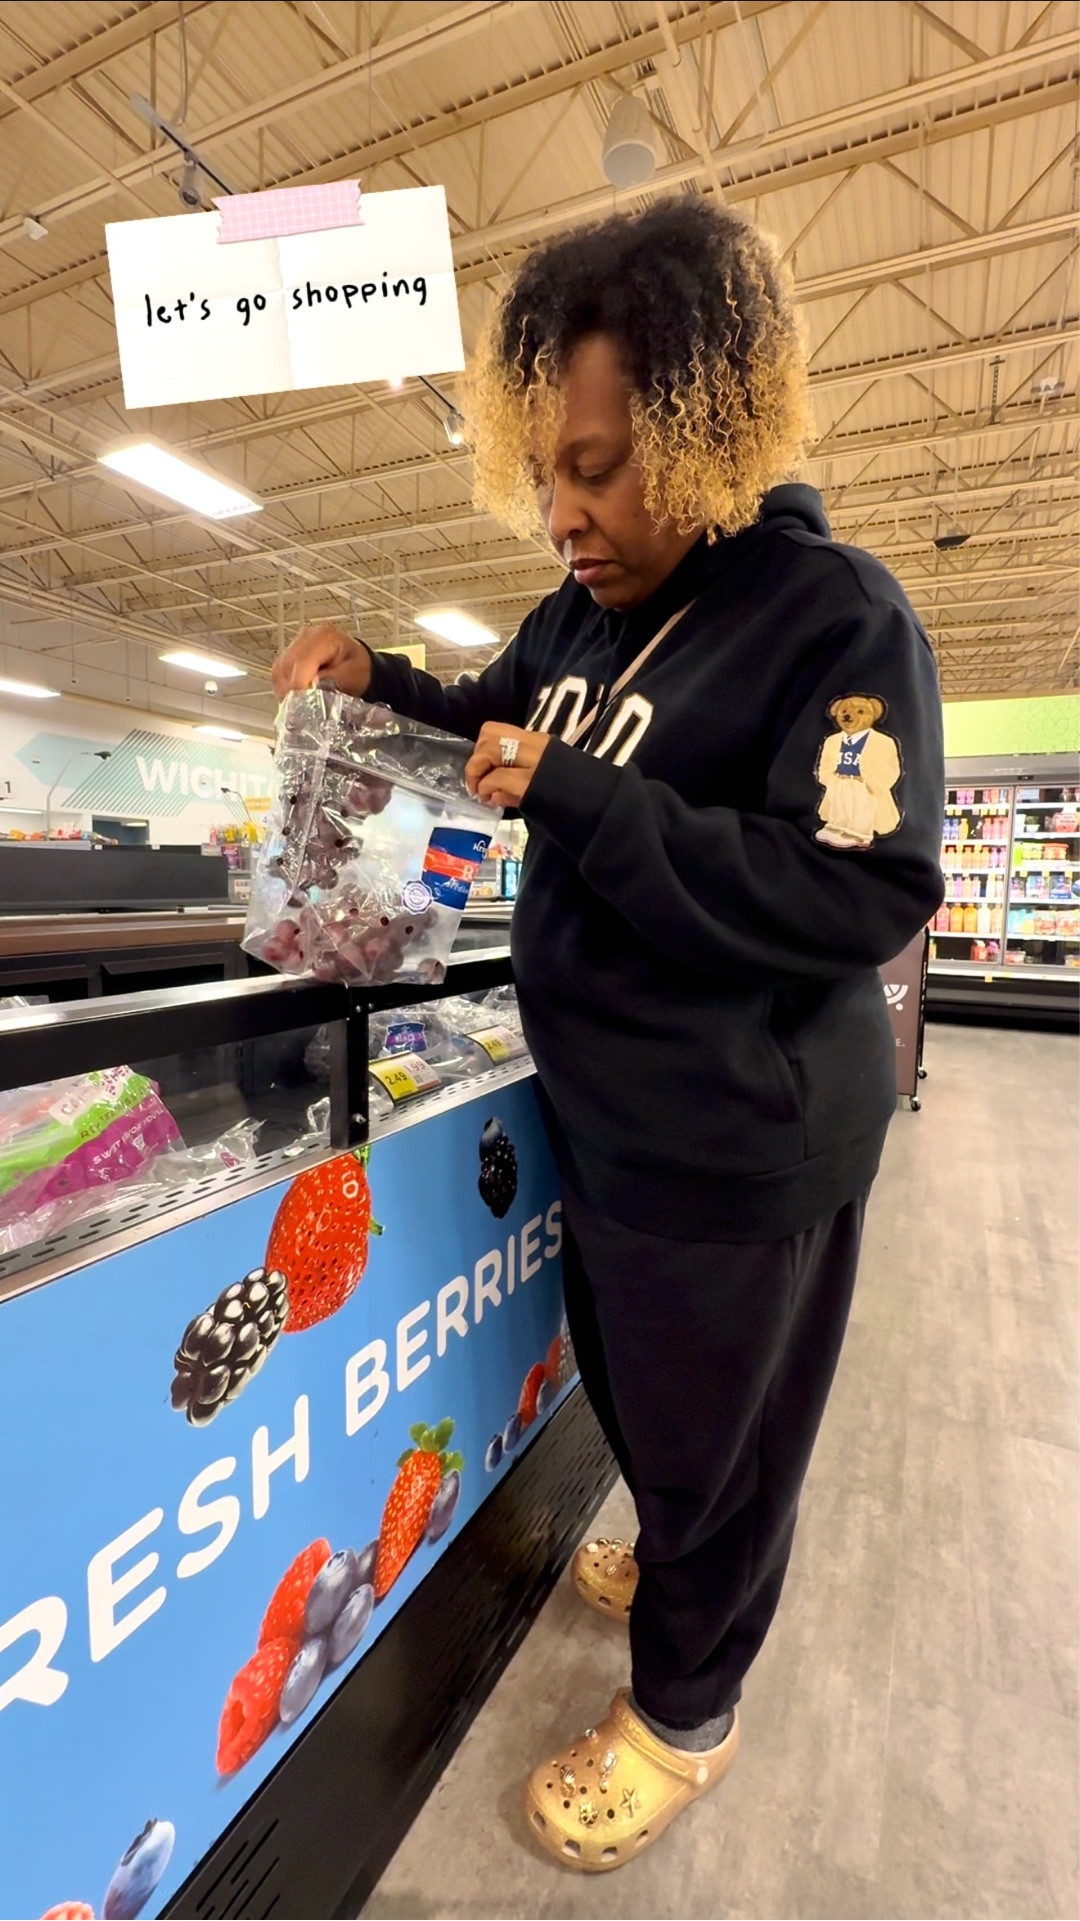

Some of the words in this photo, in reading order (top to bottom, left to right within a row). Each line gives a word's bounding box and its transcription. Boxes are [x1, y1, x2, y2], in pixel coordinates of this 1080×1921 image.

[403, 1060, 426, 1074] 1.99
[384, 1071, 407, 1085] 2.49
[346, 1200, 562, 1437] BERRIES
